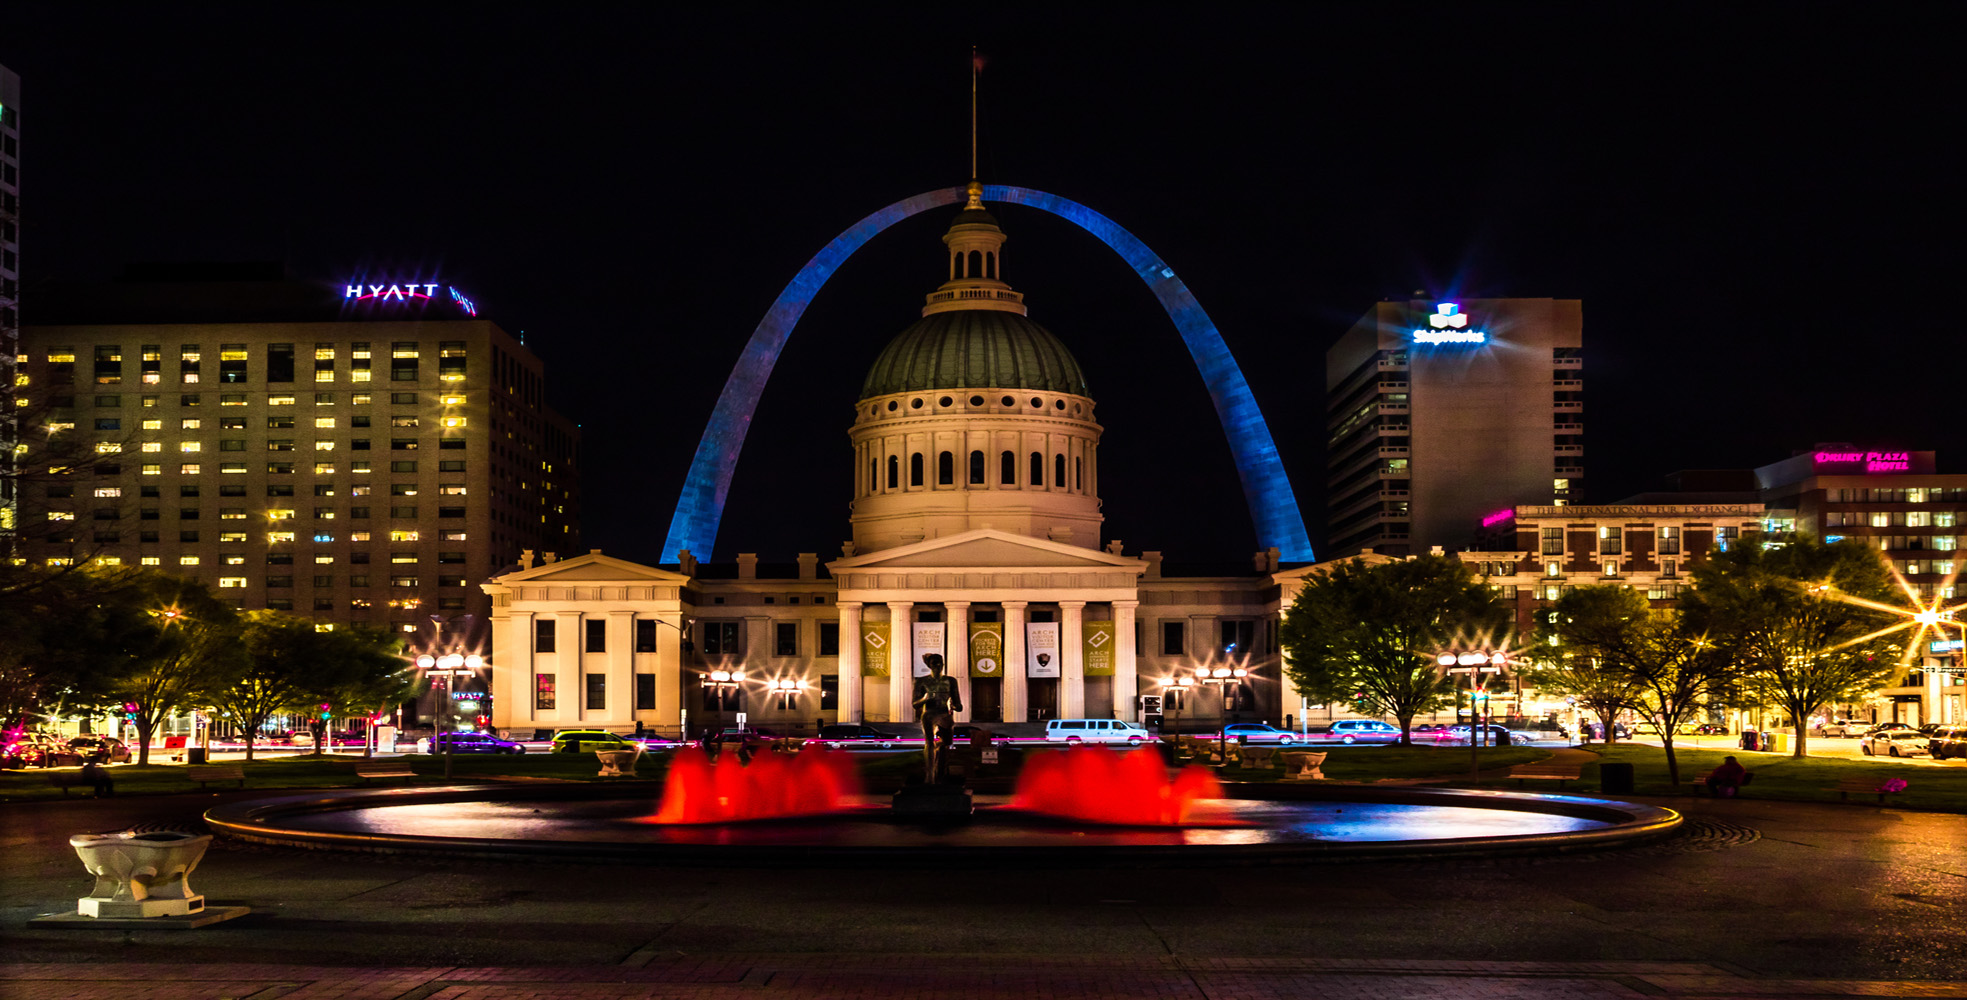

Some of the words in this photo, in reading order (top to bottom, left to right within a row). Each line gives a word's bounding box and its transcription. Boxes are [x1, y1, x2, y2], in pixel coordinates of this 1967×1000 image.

[346, 284, 439, 301] HYATT
[1866, 452, 1909, 462] PLAZA
[1868, 461, 1909, 471] HOTEL
[1537, 506, 1557, 515] THE
[1562, 506, 1651, 515] INTERNATIONAL
[1656, 505, 1677, 514] FUR
[1685, 505, 1745, 514] EXCHANGE
